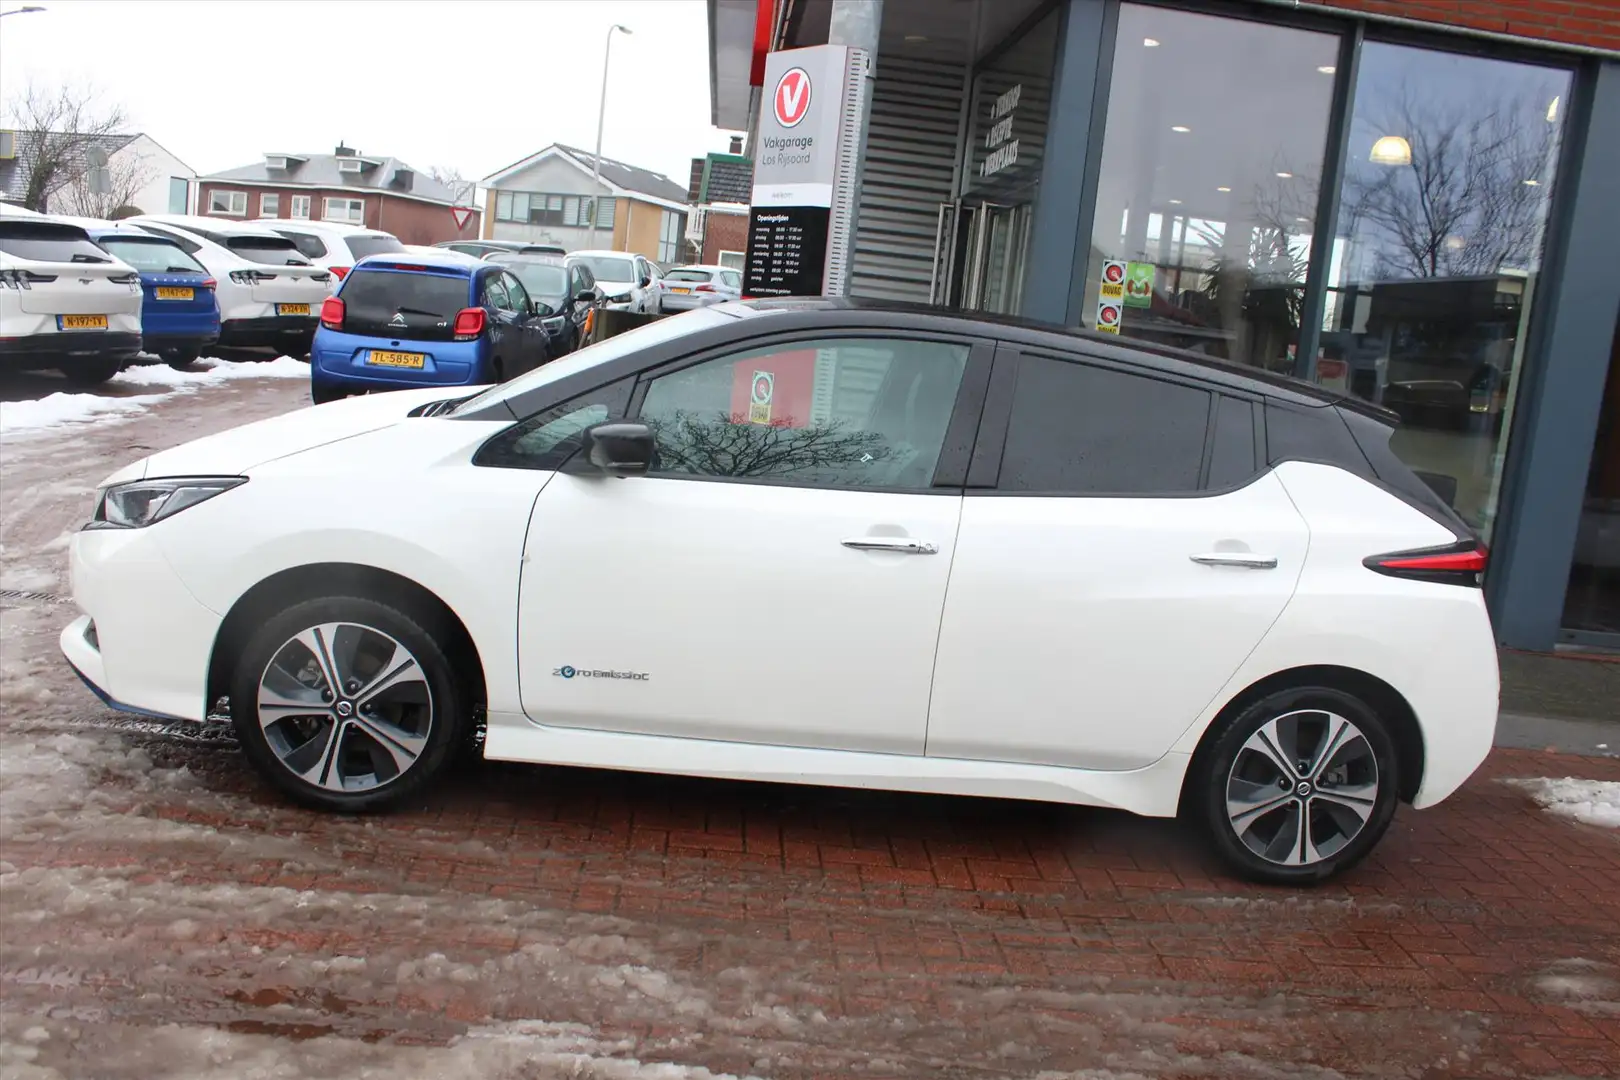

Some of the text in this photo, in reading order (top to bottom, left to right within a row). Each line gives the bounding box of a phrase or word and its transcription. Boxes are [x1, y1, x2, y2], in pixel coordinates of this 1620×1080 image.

[764, 136, 813, 151] Vakgarage
[762, 152, 811, 167] Los Rijsoord
[373, 352, 421, 365] TL-585-R
